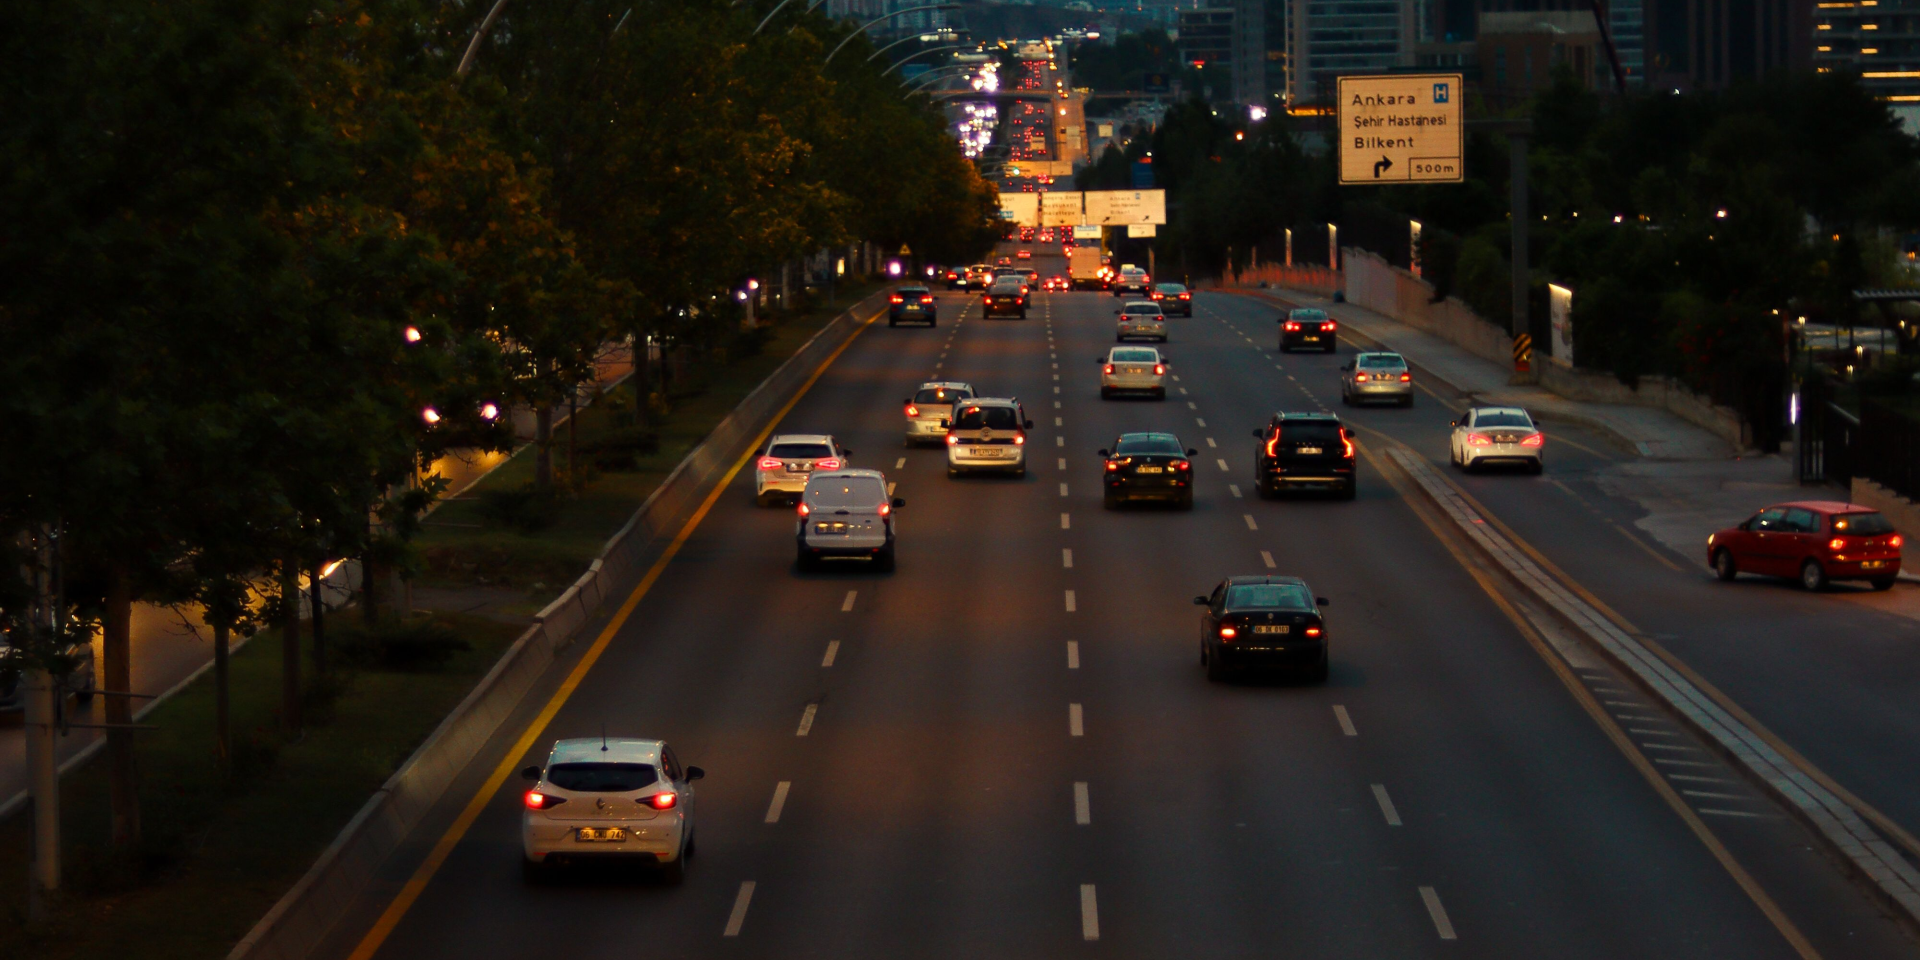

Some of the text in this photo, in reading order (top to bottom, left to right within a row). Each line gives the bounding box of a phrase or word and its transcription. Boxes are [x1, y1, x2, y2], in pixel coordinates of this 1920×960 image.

[1434, 85, 1447, 100] H
[1352, 93, 1416, 106] Ankara
[1354, 114, 1447, 129] Şehir Hastanesi
[1354, 136, 1414, 149] Bilkent
[1416, 164, 1454, 173] 500m
